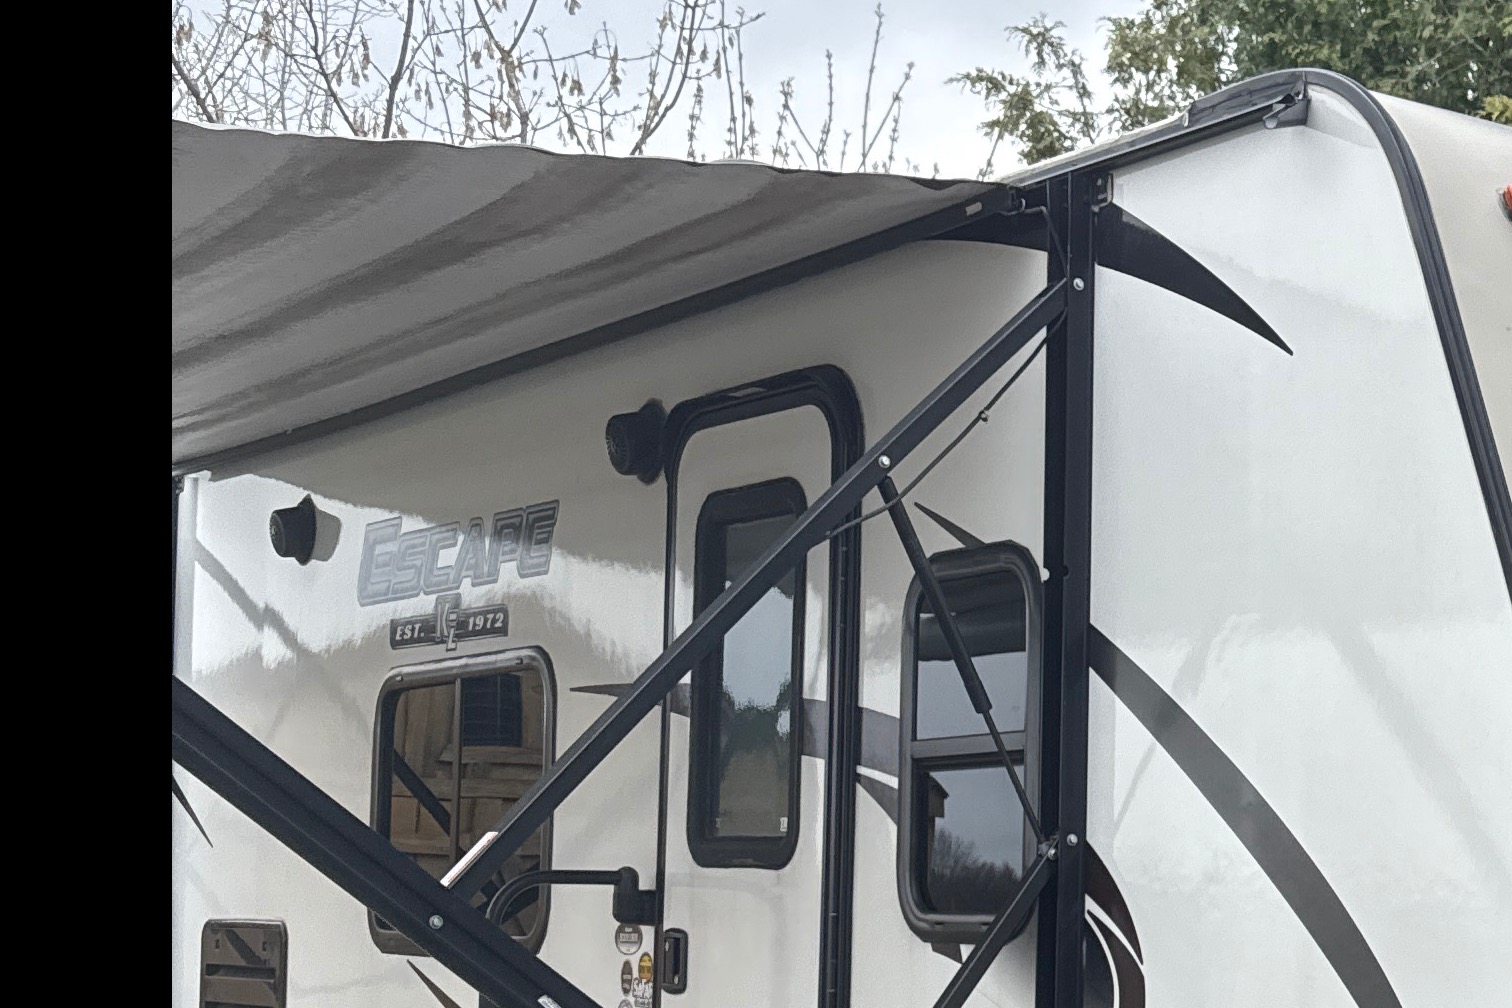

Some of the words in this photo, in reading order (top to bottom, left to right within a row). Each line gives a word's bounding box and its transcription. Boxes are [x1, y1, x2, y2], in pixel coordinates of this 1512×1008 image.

[358, 499, 560, 607] ESCAPE
[395, 623, 425, 641] EST.
[467, 612, 504, 632] 1972
